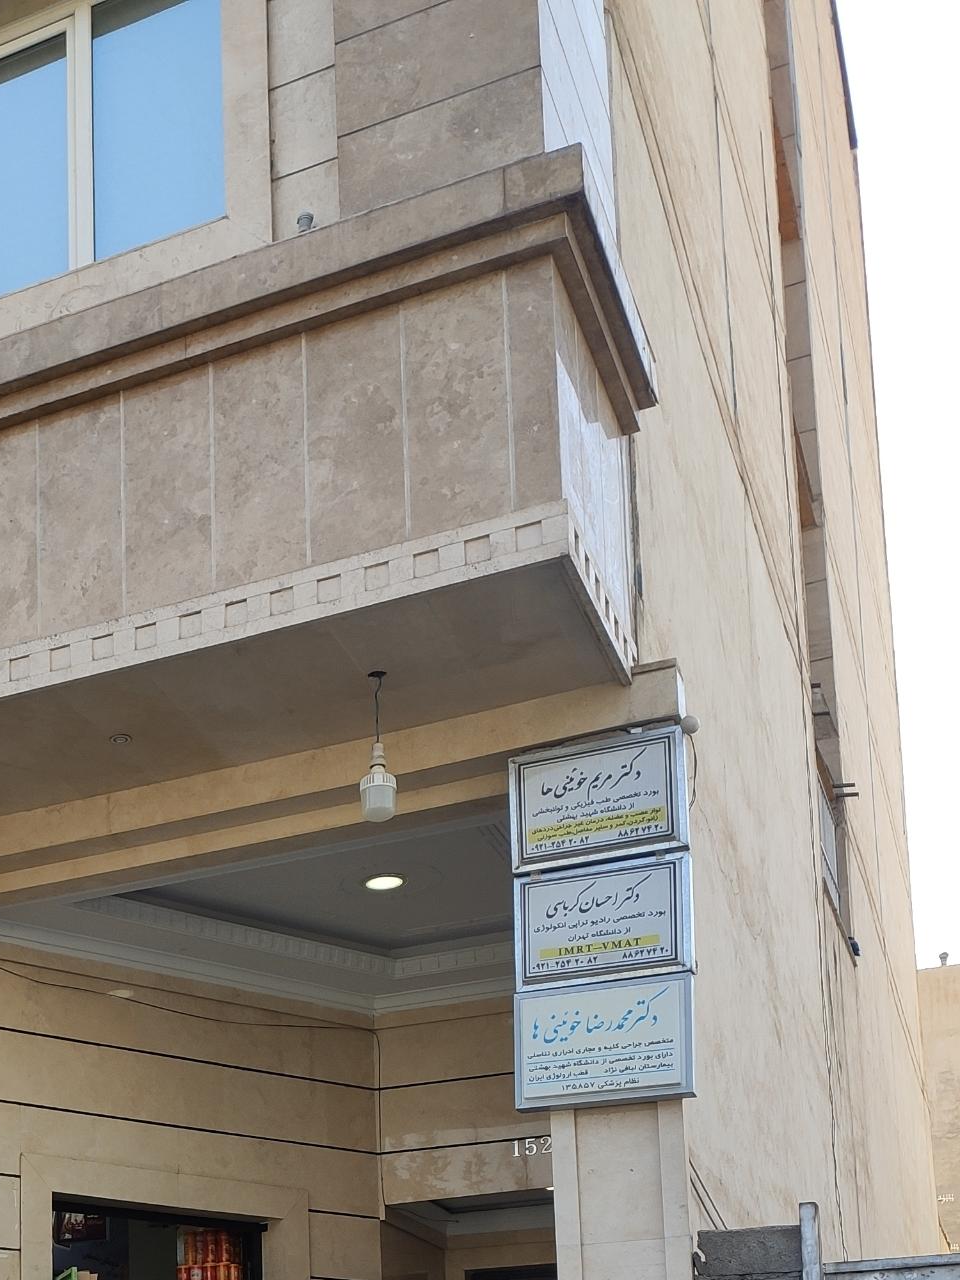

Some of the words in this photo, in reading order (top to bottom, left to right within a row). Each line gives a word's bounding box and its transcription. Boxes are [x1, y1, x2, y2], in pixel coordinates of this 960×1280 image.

[610, 747, 647, 789] دکتر
[542, 782, 552, 796] ها
[587, 771, 612, 800] مریم
[613, 791, 641, 803] تخصصی
[643, 789, 659, 797] بورد
[596, 797, 611, 805] طب
[600, 804, 626, 814] دانشگاه
[629, 802, 635, 810] از
[580, 809, 598, 819] شهید
[556, 814, 578, 824] بهشتی
[615, 873, 652, 911] دکتر
[546, 881, 597, 918] کرباسی
[579, 892, 618, 913] احسان
[613, 911, 645, 924] تخصصی
[648, 910, 666, 918] بورد
[568, 919, 588, 930] تراپی
[590, 917, 611, 927] رادیو
[534, 923, 566, 933] انکولوژی
[624, 927, 631, 935] از
[568, 934, 589, 942] تهران
[592, 929, 621, 938] دانشگاه
[626, 986, 670, 1032] دکتر
[621, 1041, 642, 1050] جراحی
[644, 1038, 674, 1046] متخصص
[575, 1046, 596, 1054] مجاری
[604, 1043, 619, 1051] کلیه
[528, 1051, 550, 1060] تناسلی
[552, 1048, 574, 1057] ادراری
[657, 1051, 673, 1059] دارای
[573, 1058, 599, 1067] دانشگاه
[609, 1055, 636, 1065] تخصصی
[528, 1065, 551, 1073] بهشتی
[553, 1062, 572, 1070] شهید
[604, 1066, 617, 1074] نژاد
[638, 1062, 674, 1071] بیمارستان
[528, 1074, 545, 1082] ایران
[623, 1078, 640, 1086] نظام
[597, 1080, 622, 1090] پزشکی
[512, 1136, 552, 1157] 152
